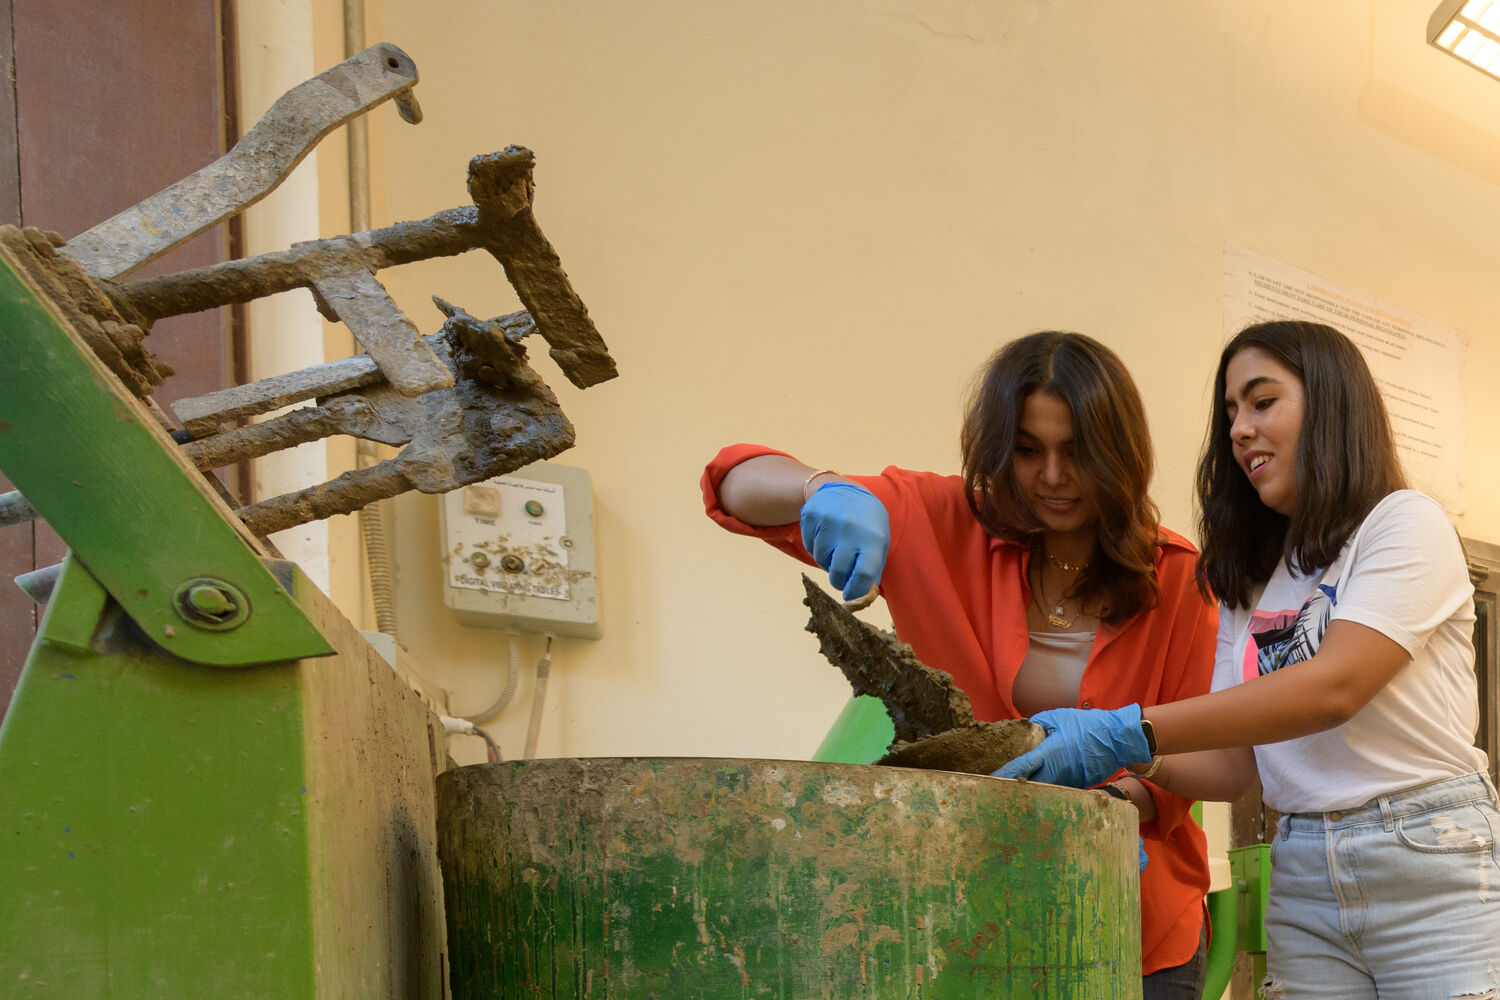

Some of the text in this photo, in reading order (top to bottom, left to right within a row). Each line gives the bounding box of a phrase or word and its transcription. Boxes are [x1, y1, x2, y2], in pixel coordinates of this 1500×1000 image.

[474, 517, 497, 527] TIME
[460, 576, 489, 588] DIGITAL
[491, 580, 531, 592] VIBRAING
